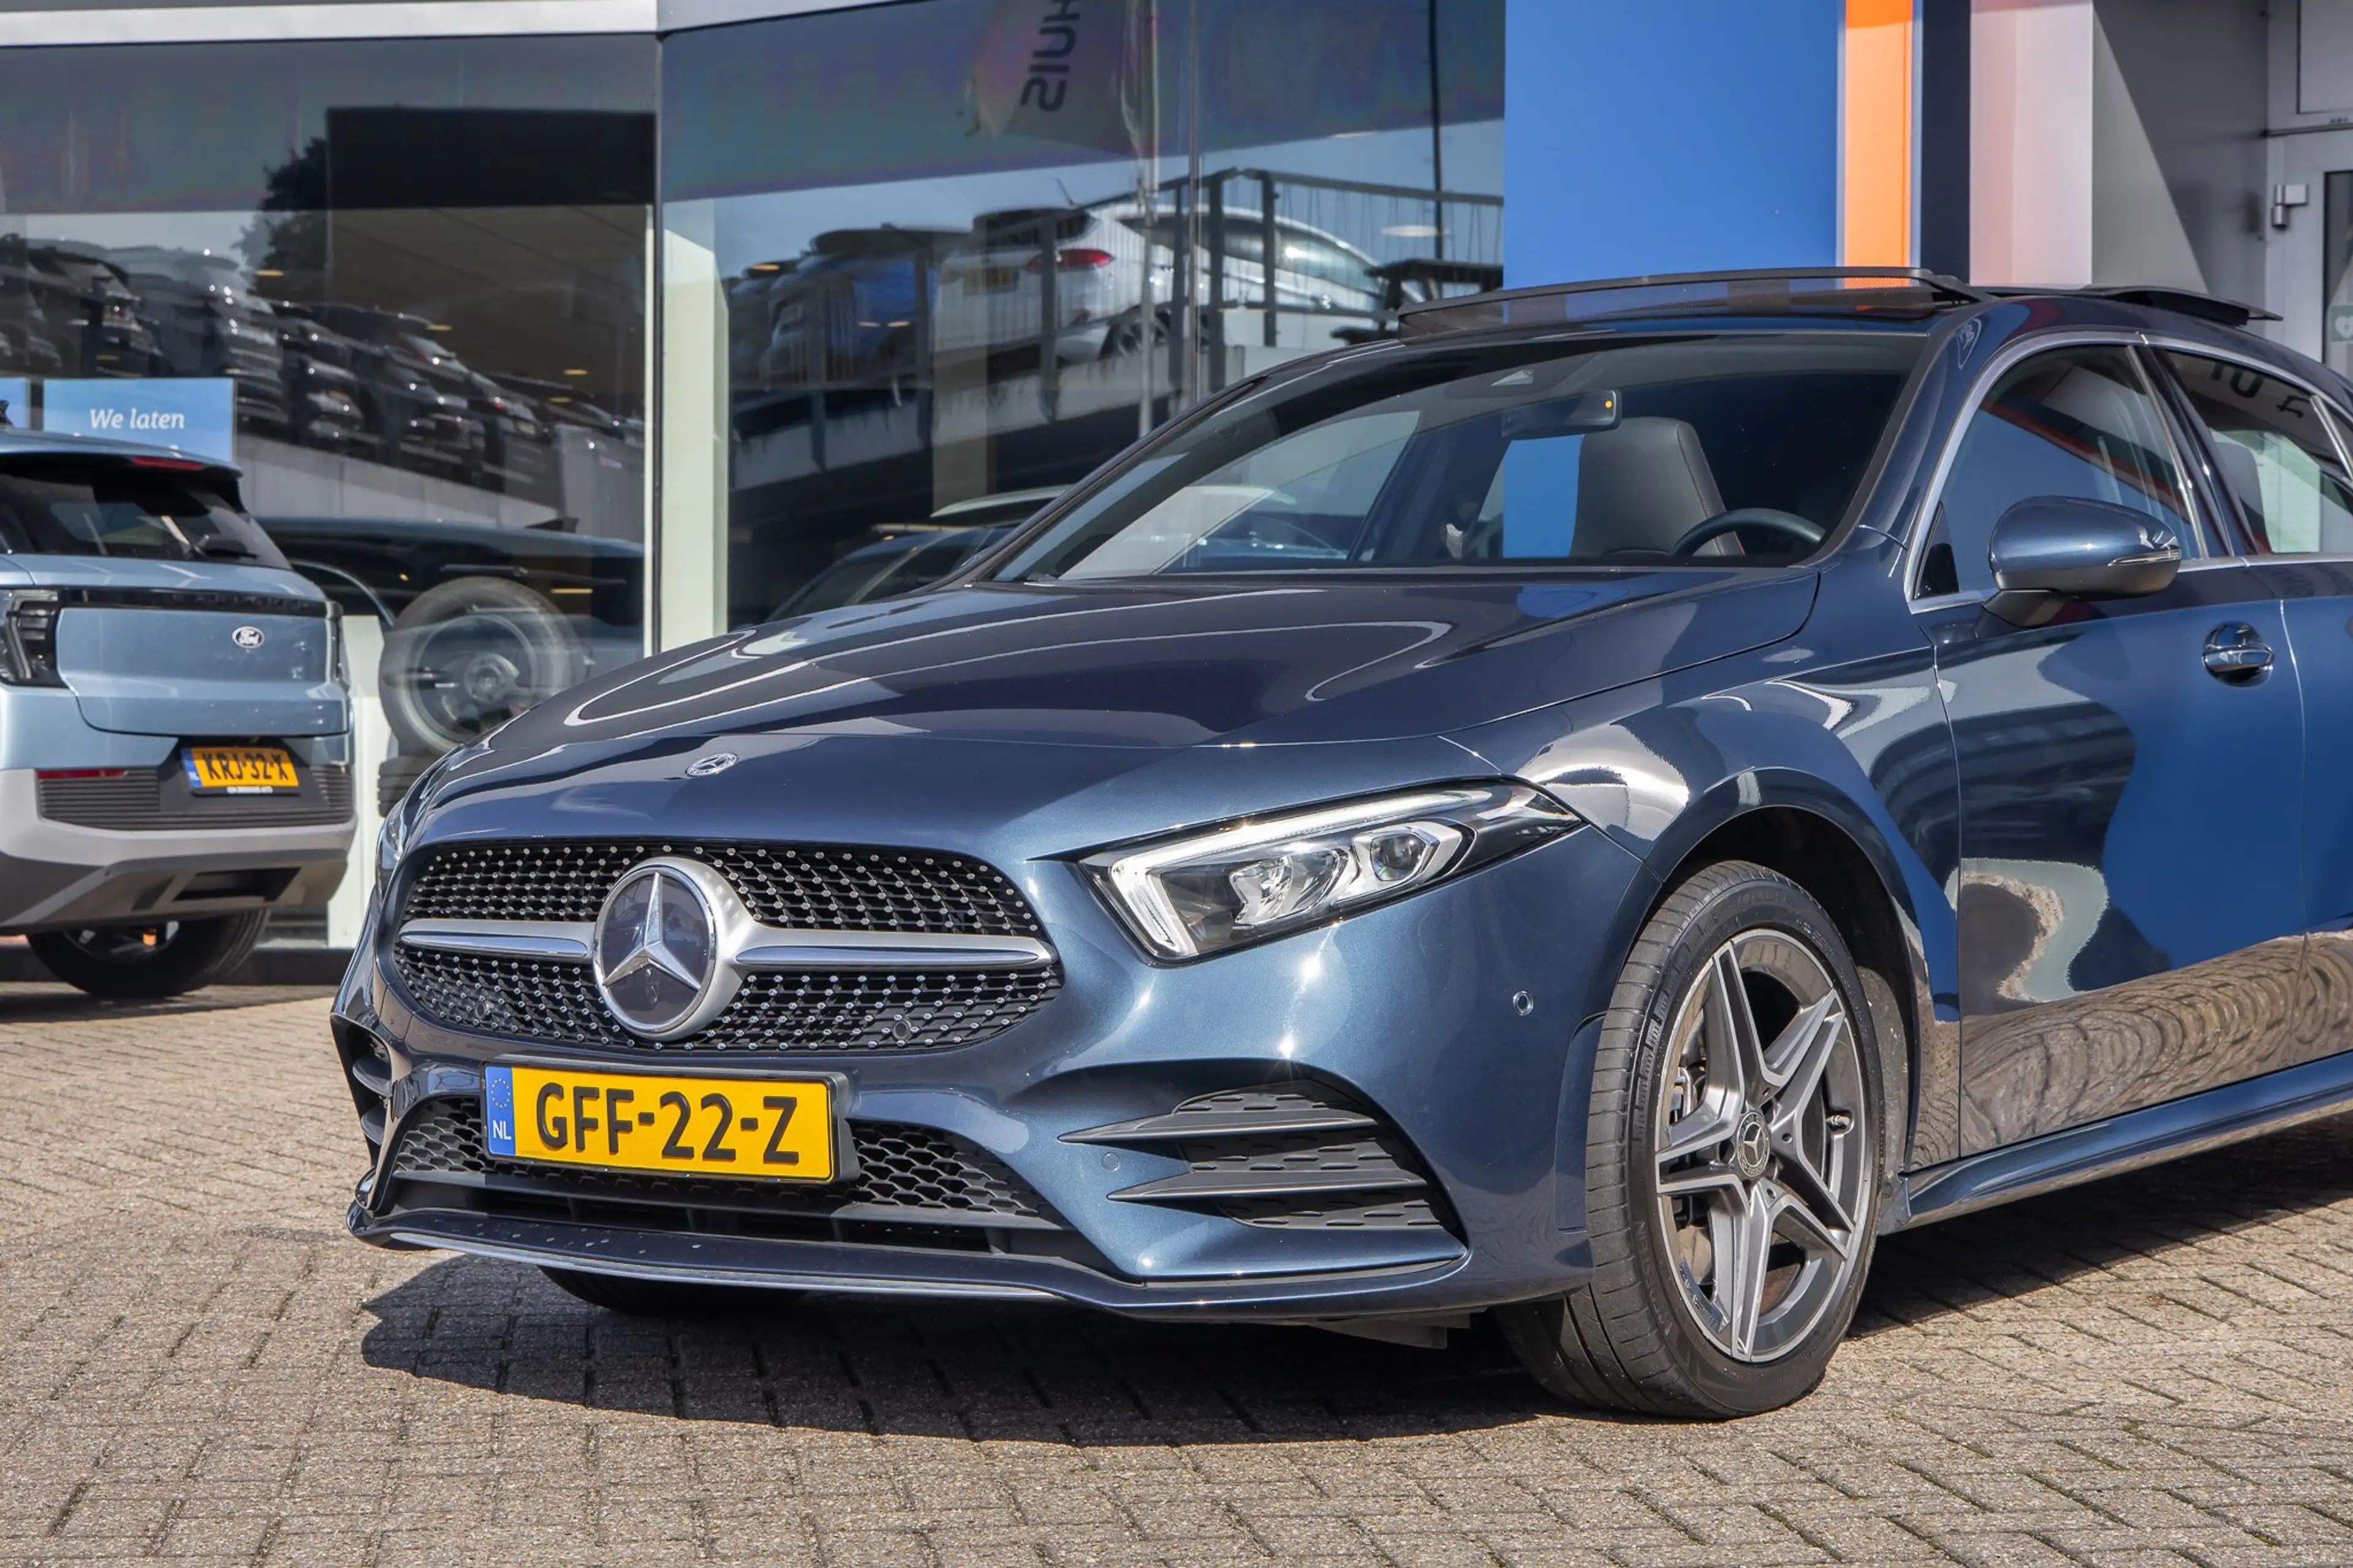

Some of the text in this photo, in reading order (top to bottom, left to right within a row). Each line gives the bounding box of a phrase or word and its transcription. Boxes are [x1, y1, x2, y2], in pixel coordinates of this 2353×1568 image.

[89, 407, 185, 429] We laten
[202, 752, 289, 780] KRJ-32-X
[492, 1119, 512, 1140] NL
[536, 1082, 799, 1165] GFF-22-Z
